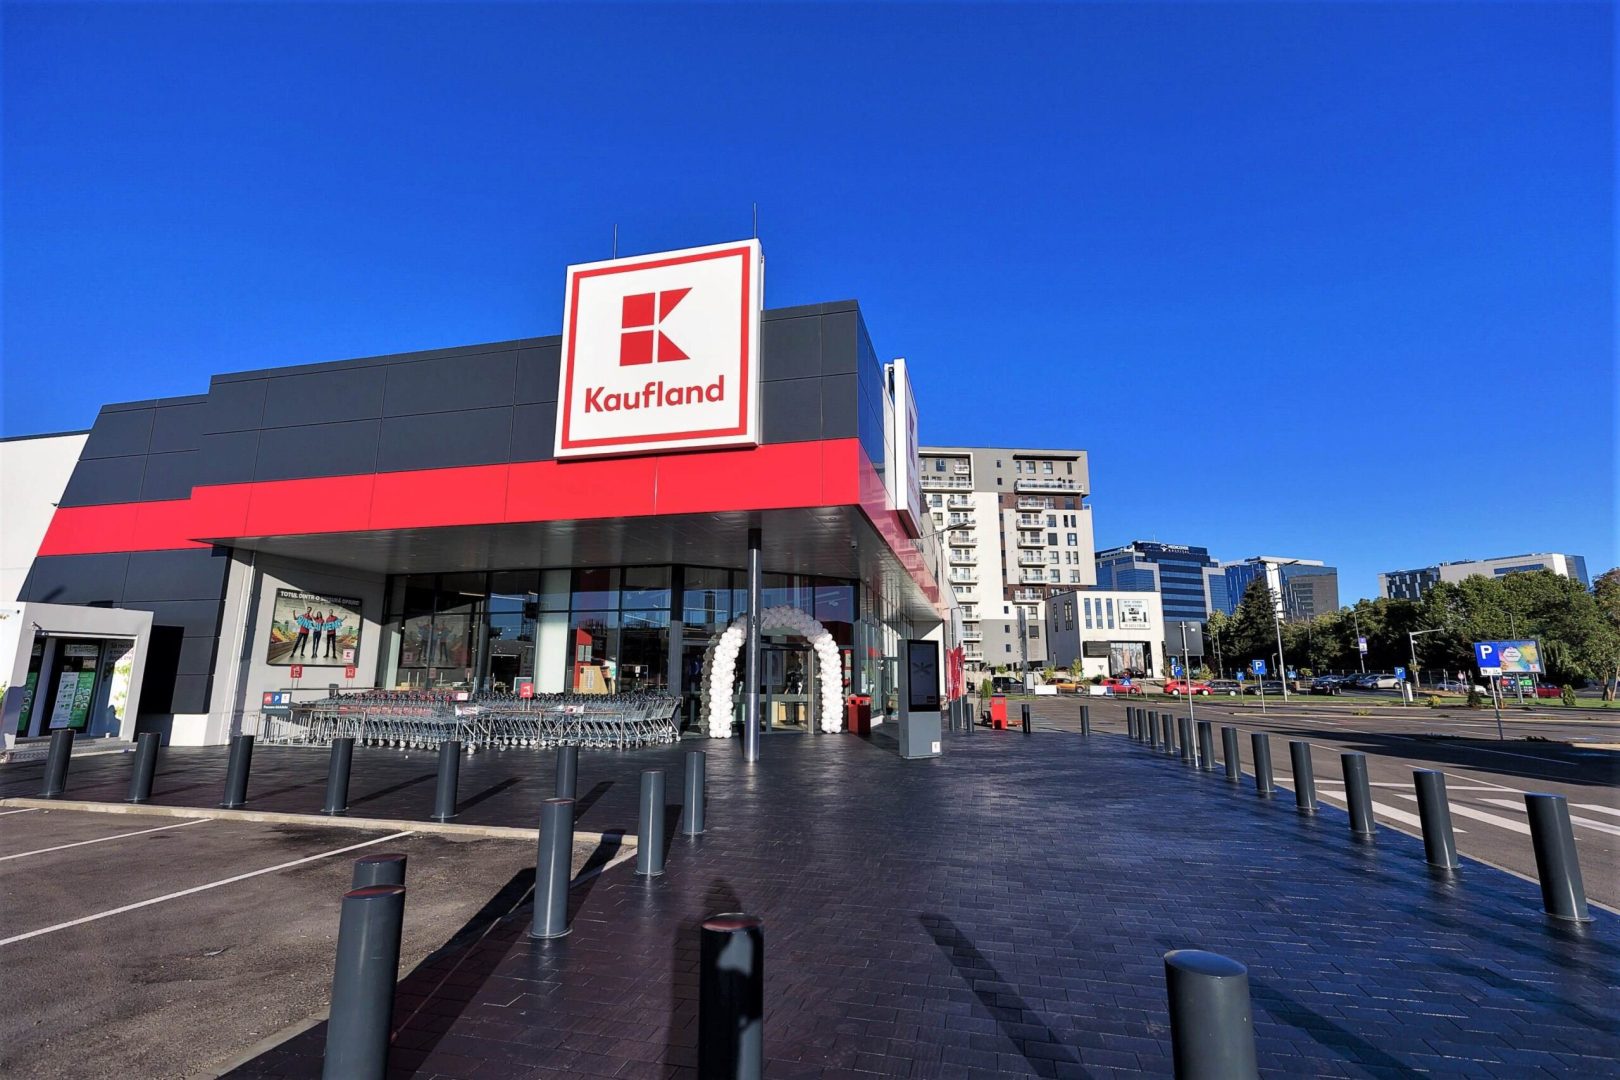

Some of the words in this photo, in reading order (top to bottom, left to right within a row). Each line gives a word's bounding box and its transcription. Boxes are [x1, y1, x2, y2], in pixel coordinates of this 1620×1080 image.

[585, 375, 724, 413] Kaufland
[1480, 645, 1492, 659] P
[1256, 661, 1262, 670] P
